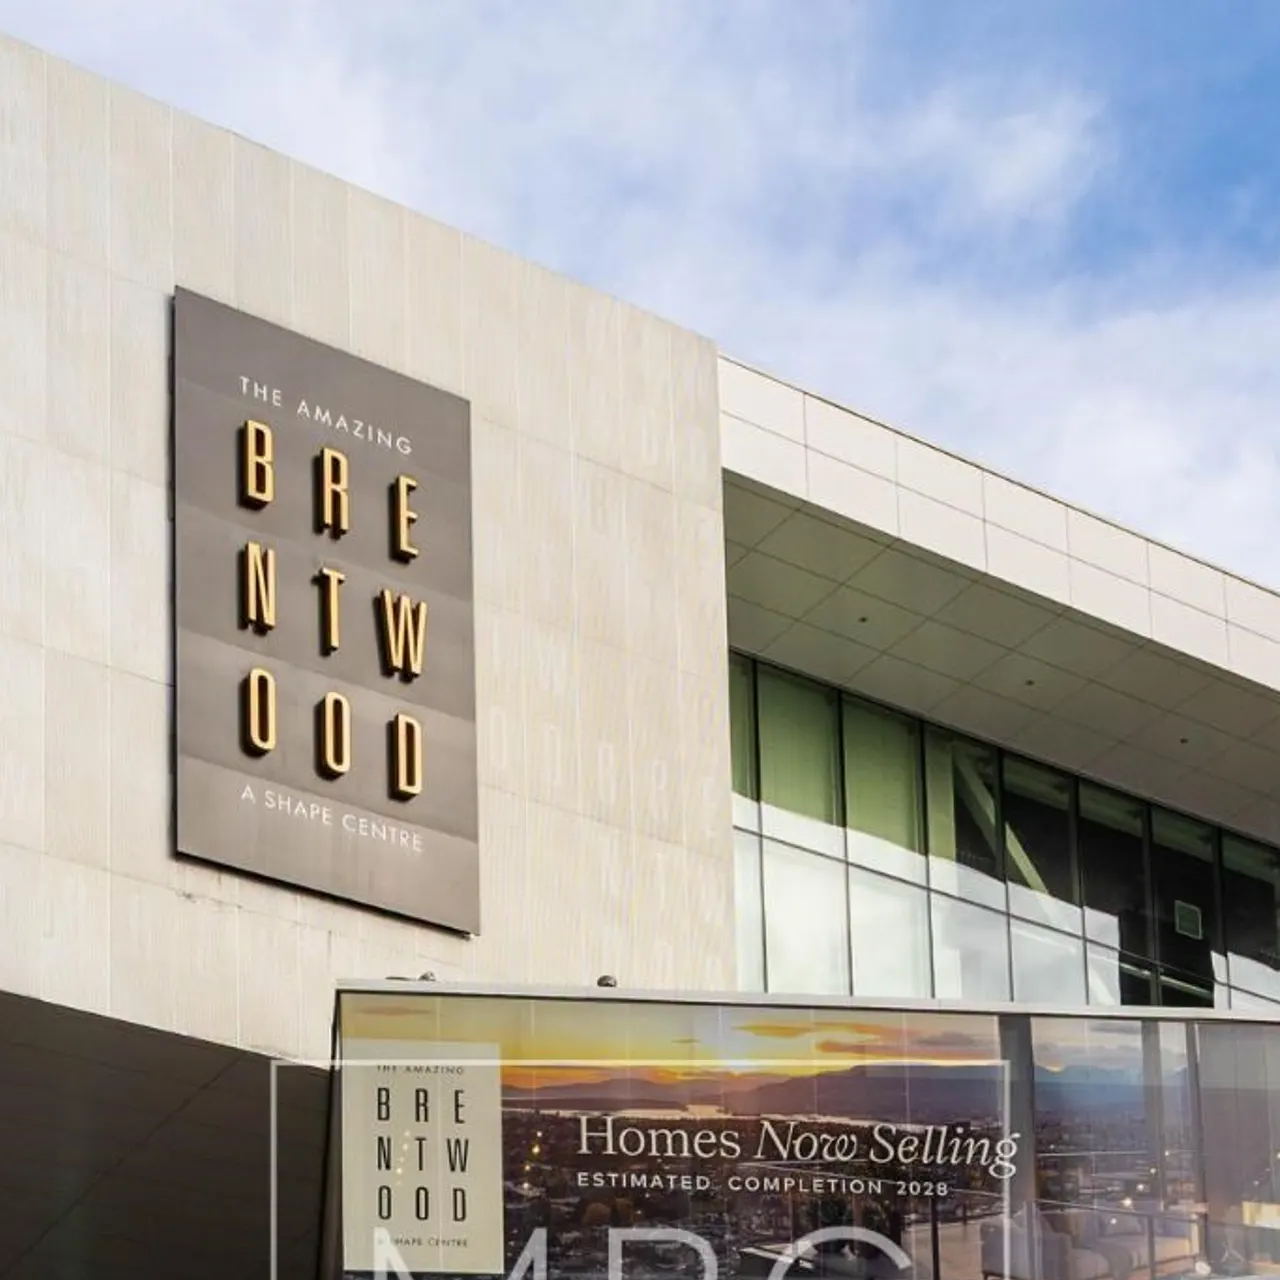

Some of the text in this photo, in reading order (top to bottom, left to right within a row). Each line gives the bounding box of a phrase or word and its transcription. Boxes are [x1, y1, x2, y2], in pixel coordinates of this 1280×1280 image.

[239, 376, 413, 456] THE AMAZING
[241, 784, 424, 852] A SHAPE CENTRE
[577, 1115, 1021, 1179] Homes Now Selling
[577, 1172, 949, 1197] ESTIMATED COMPLETION 2028
